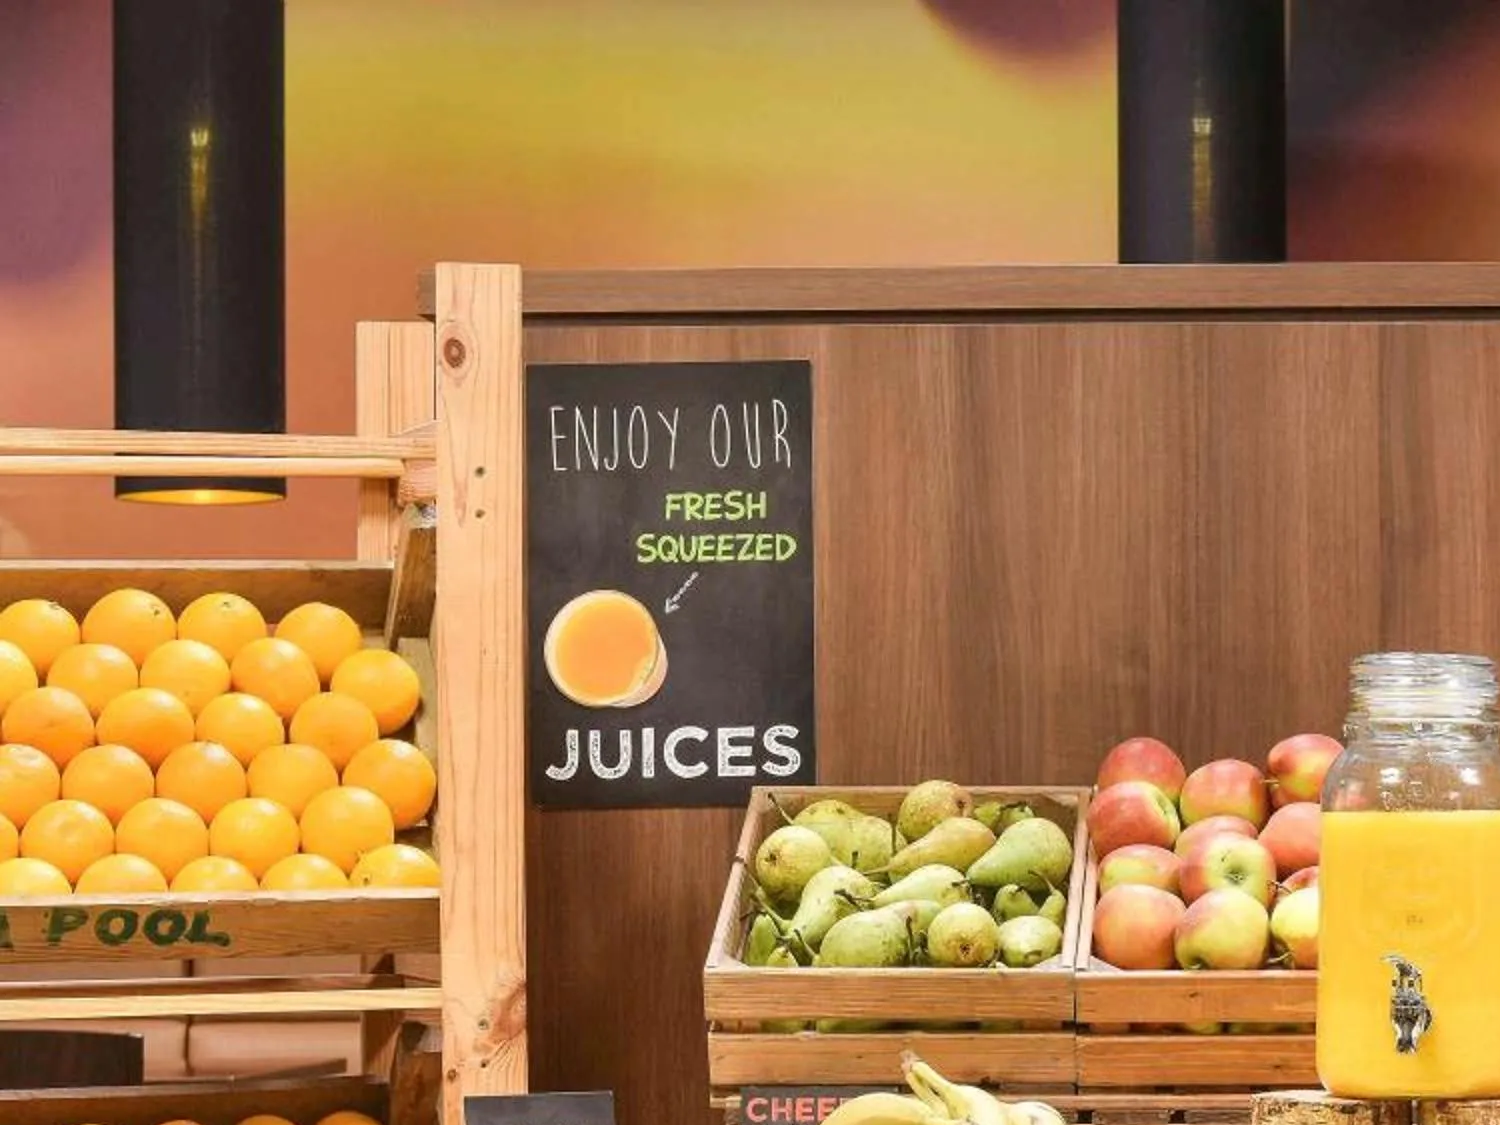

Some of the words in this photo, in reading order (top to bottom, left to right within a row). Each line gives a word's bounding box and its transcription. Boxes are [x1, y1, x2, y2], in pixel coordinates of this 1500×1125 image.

[550, 405, 680, 472] ENJOY
[709, 399, 792, 469] OUR
[665, 491, 768, 521] FRESH
[636, 533, 797, 563] SQUEEZED
[545, 725, 801, 781] JUICES
[47, 907, 231, 947] POOL
[746, 1096, 850, 1123] CHEE
